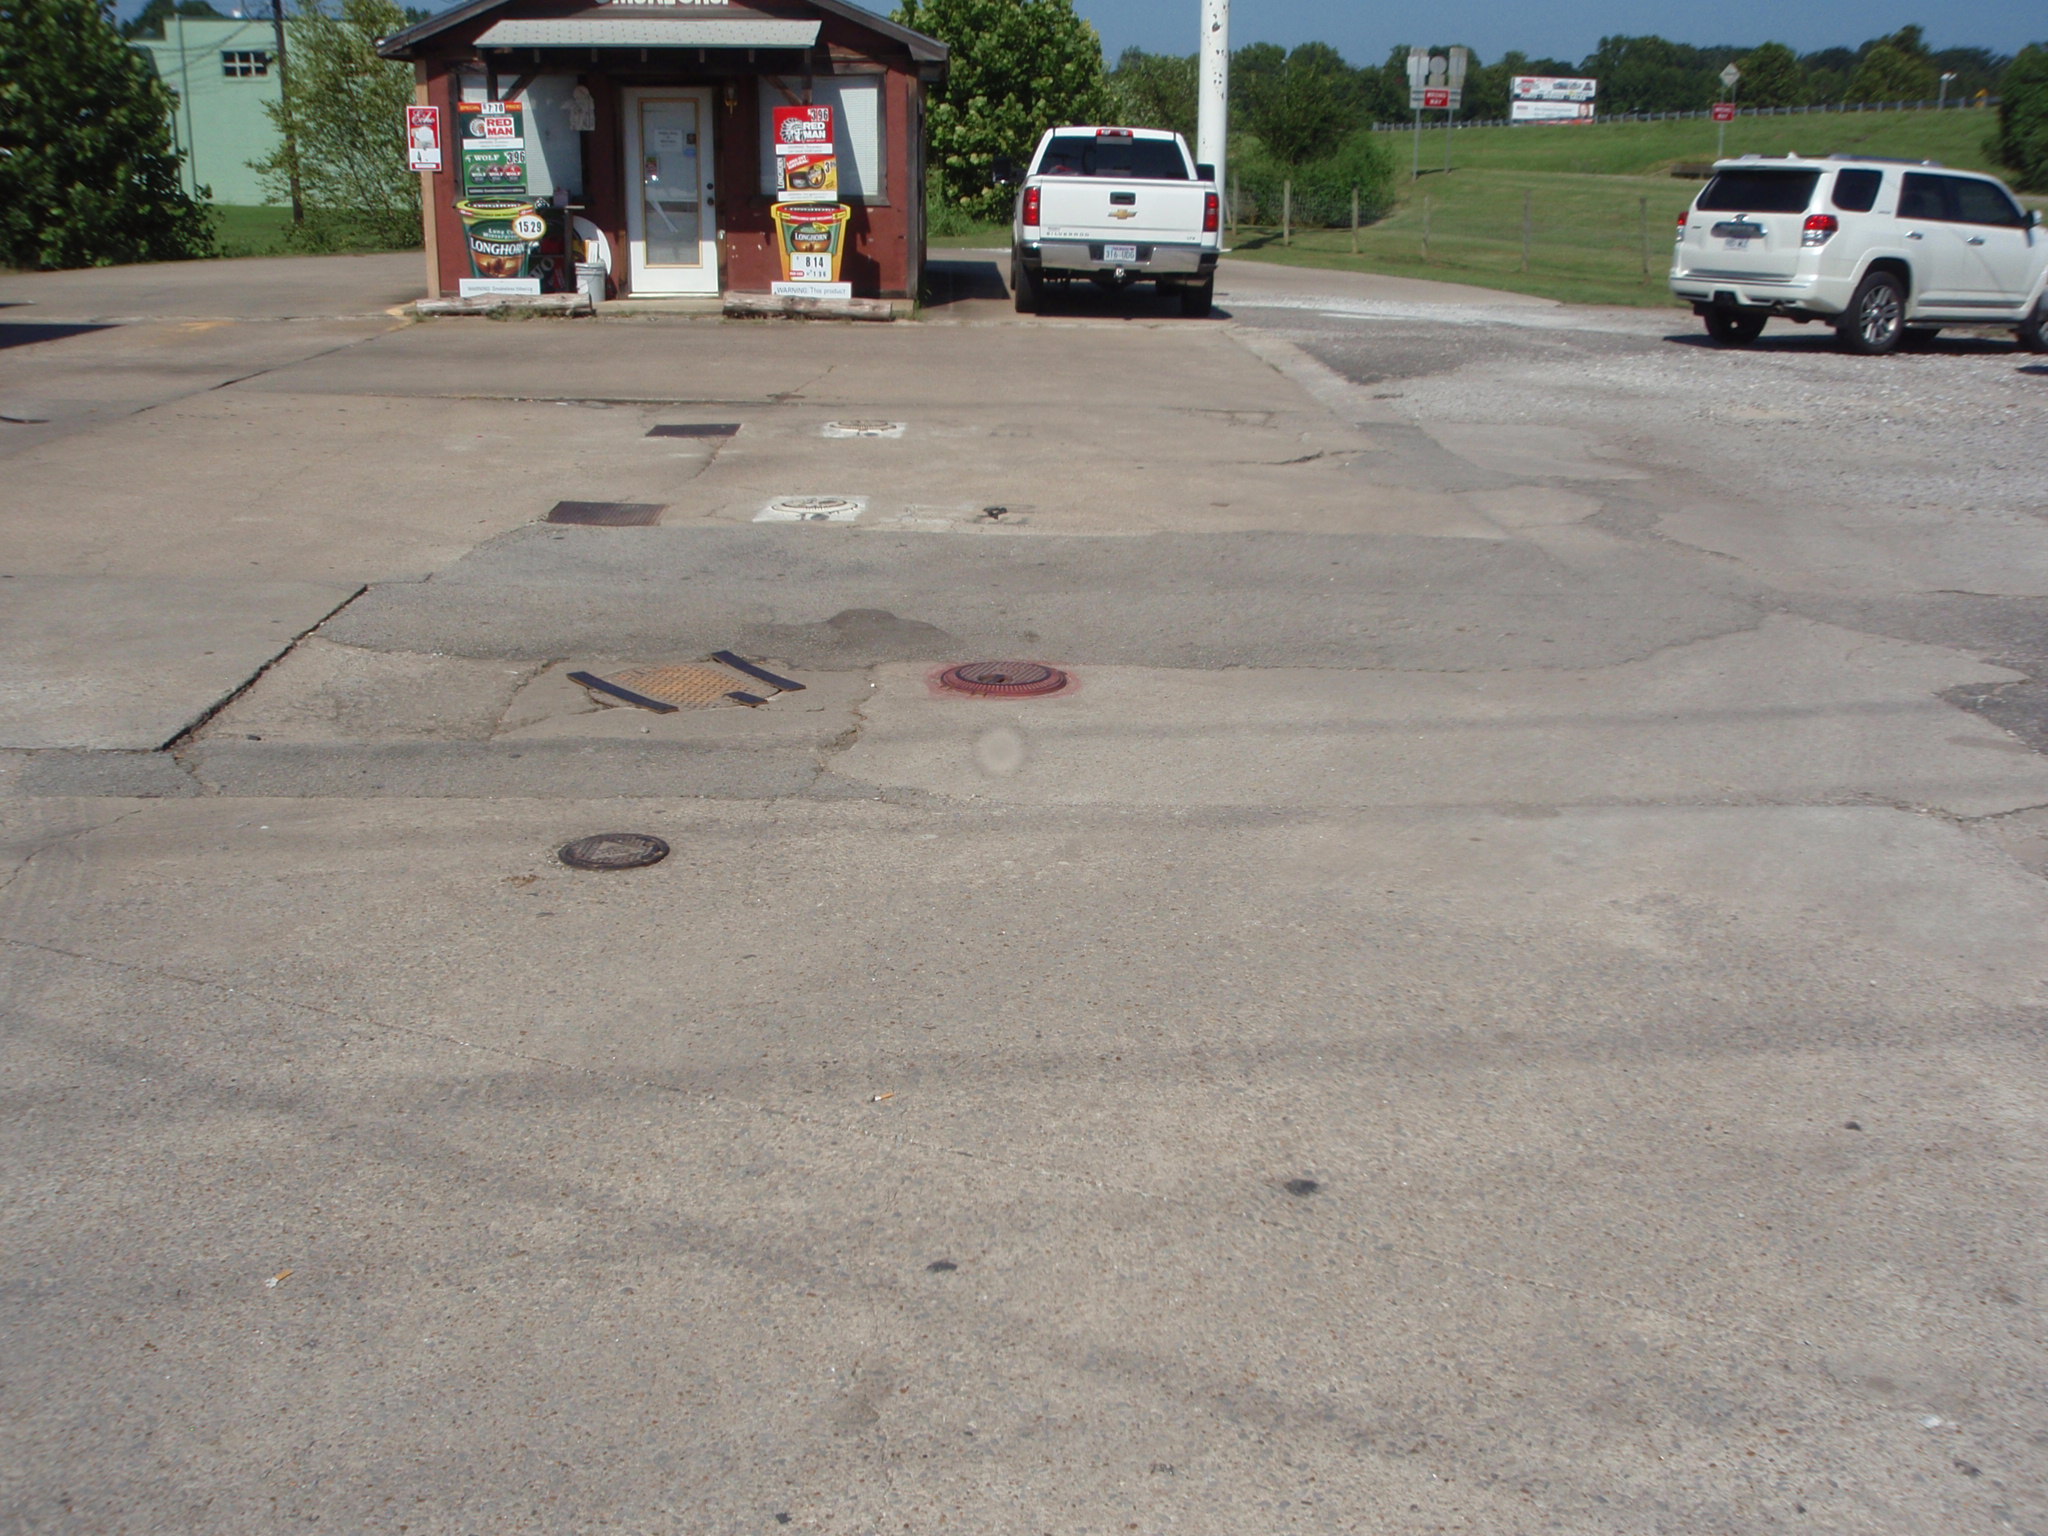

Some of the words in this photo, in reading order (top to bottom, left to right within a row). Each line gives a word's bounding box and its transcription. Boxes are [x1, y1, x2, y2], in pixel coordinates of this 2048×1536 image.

[487, 118, 512, 126] RED
[803, 122, 825, 130] RED
[487, 127, 513, 136] MAN
[804, 130, 826, 139] MAN
[474, 154, 499, 162] WOLF
[795, 232, 828, 241] LONGHORN
[470, 237, 525, 255] LONGHORN
[810, 286, 823, 294] This
[824, 286, 845, 296] product
